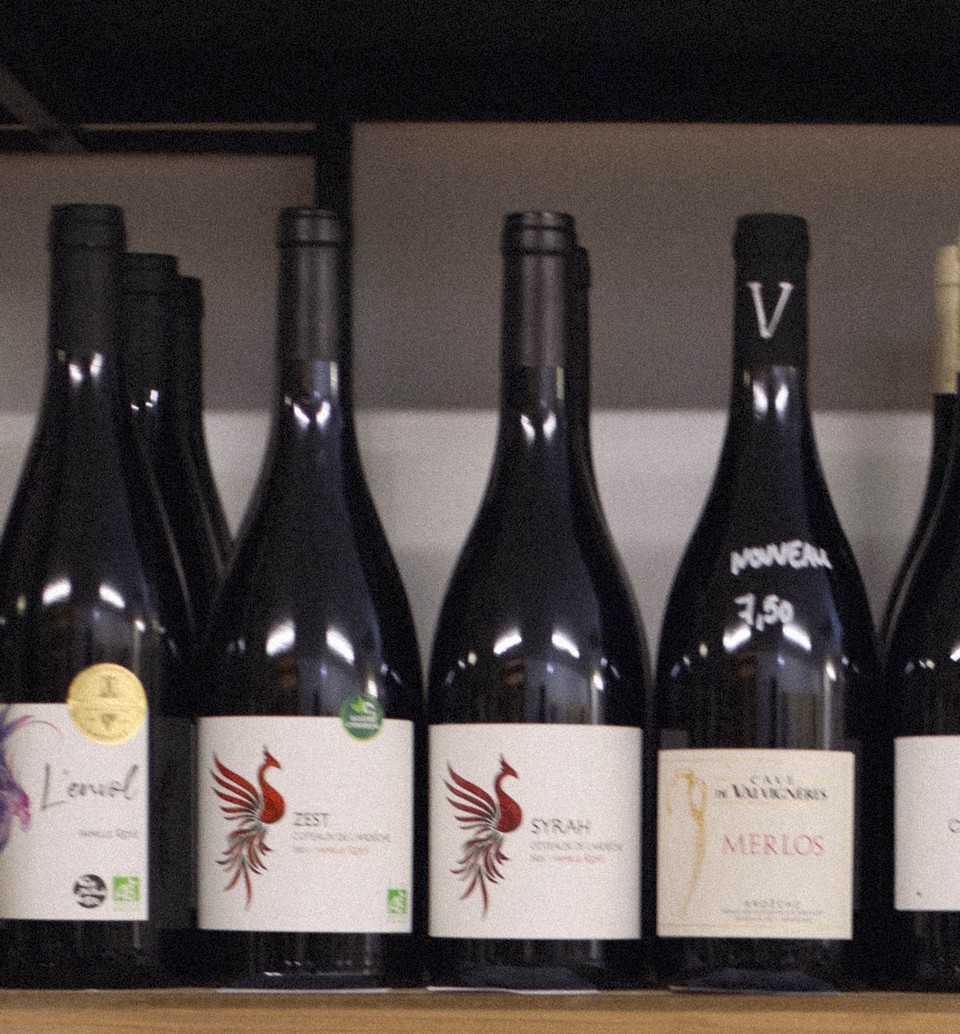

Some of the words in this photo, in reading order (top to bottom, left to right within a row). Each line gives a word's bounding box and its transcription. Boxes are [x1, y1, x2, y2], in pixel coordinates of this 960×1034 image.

[748, 281, 794, 338] V
[734, 592, 794, 632] 7,50
[293, 811, 330, 827] ZEST
[530, 817, 591, 835] SYRAH
[722, 832, 826, 857] MERLOS
